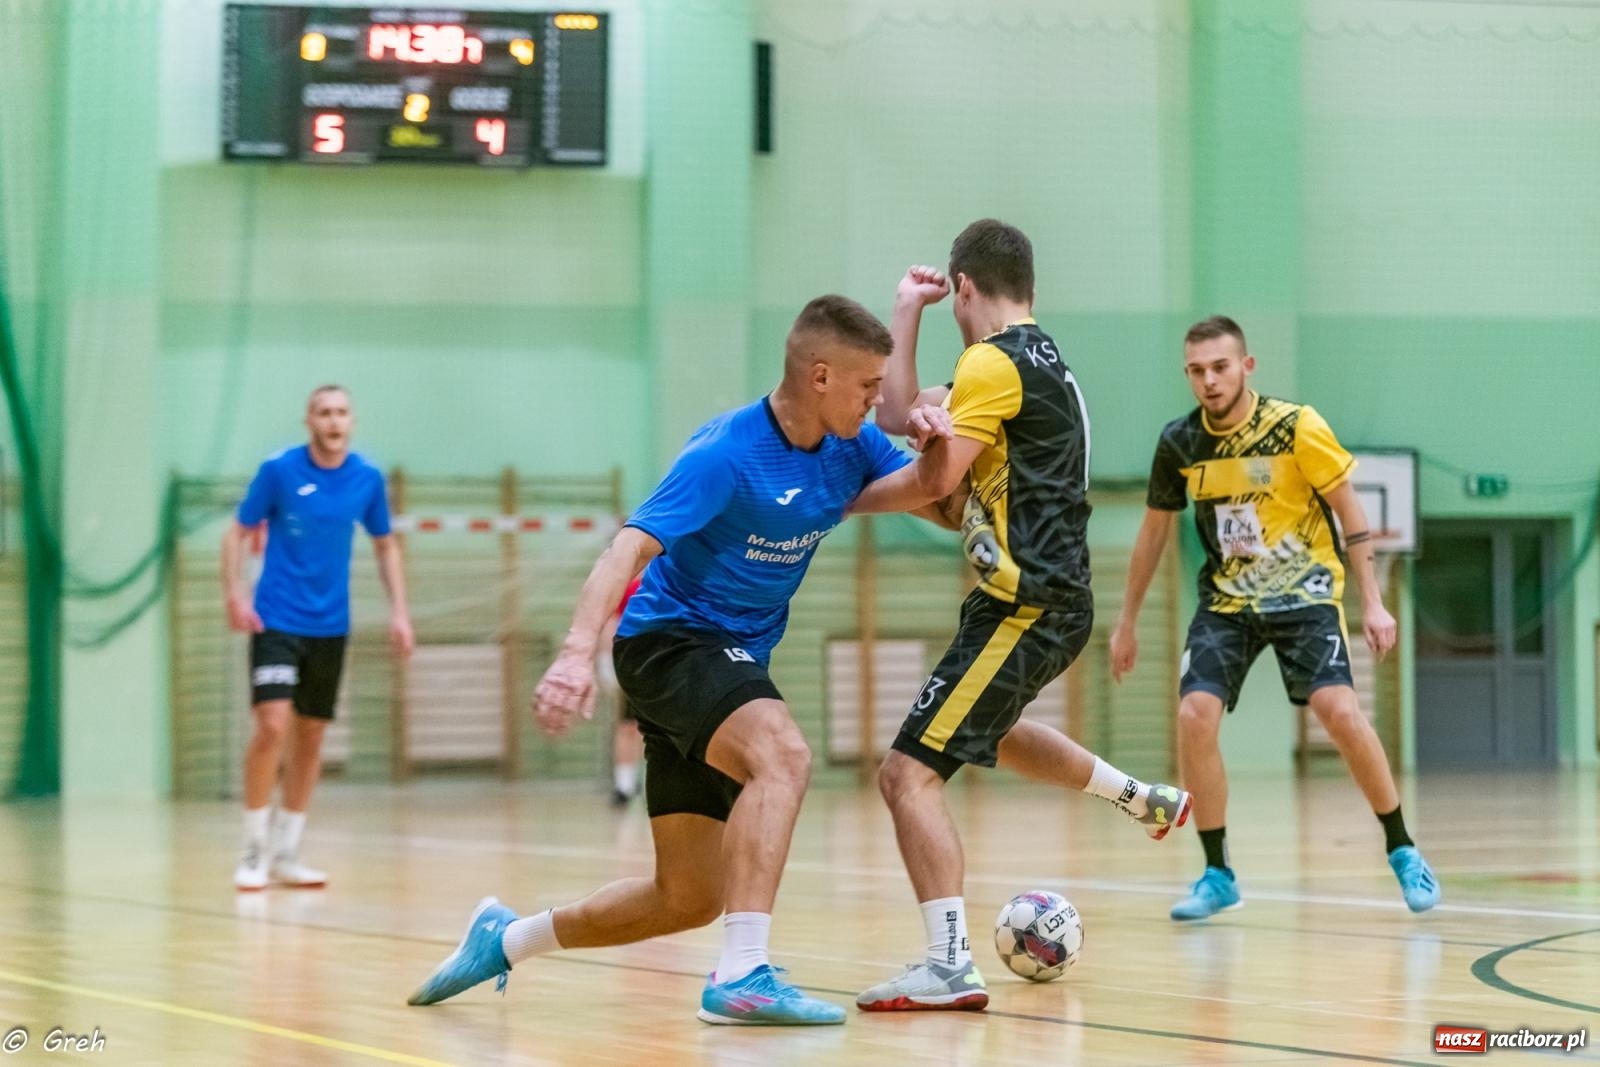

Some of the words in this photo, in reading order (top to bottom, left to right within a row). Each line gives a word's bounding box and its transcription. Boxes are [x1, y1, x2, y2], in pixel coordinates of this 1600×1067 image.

[404, 93, 430, 122] 2
[313, 113, 345, 154] 5
[475, 118, 507, 155] 4
[1025, 341, 1058, 368] KS
